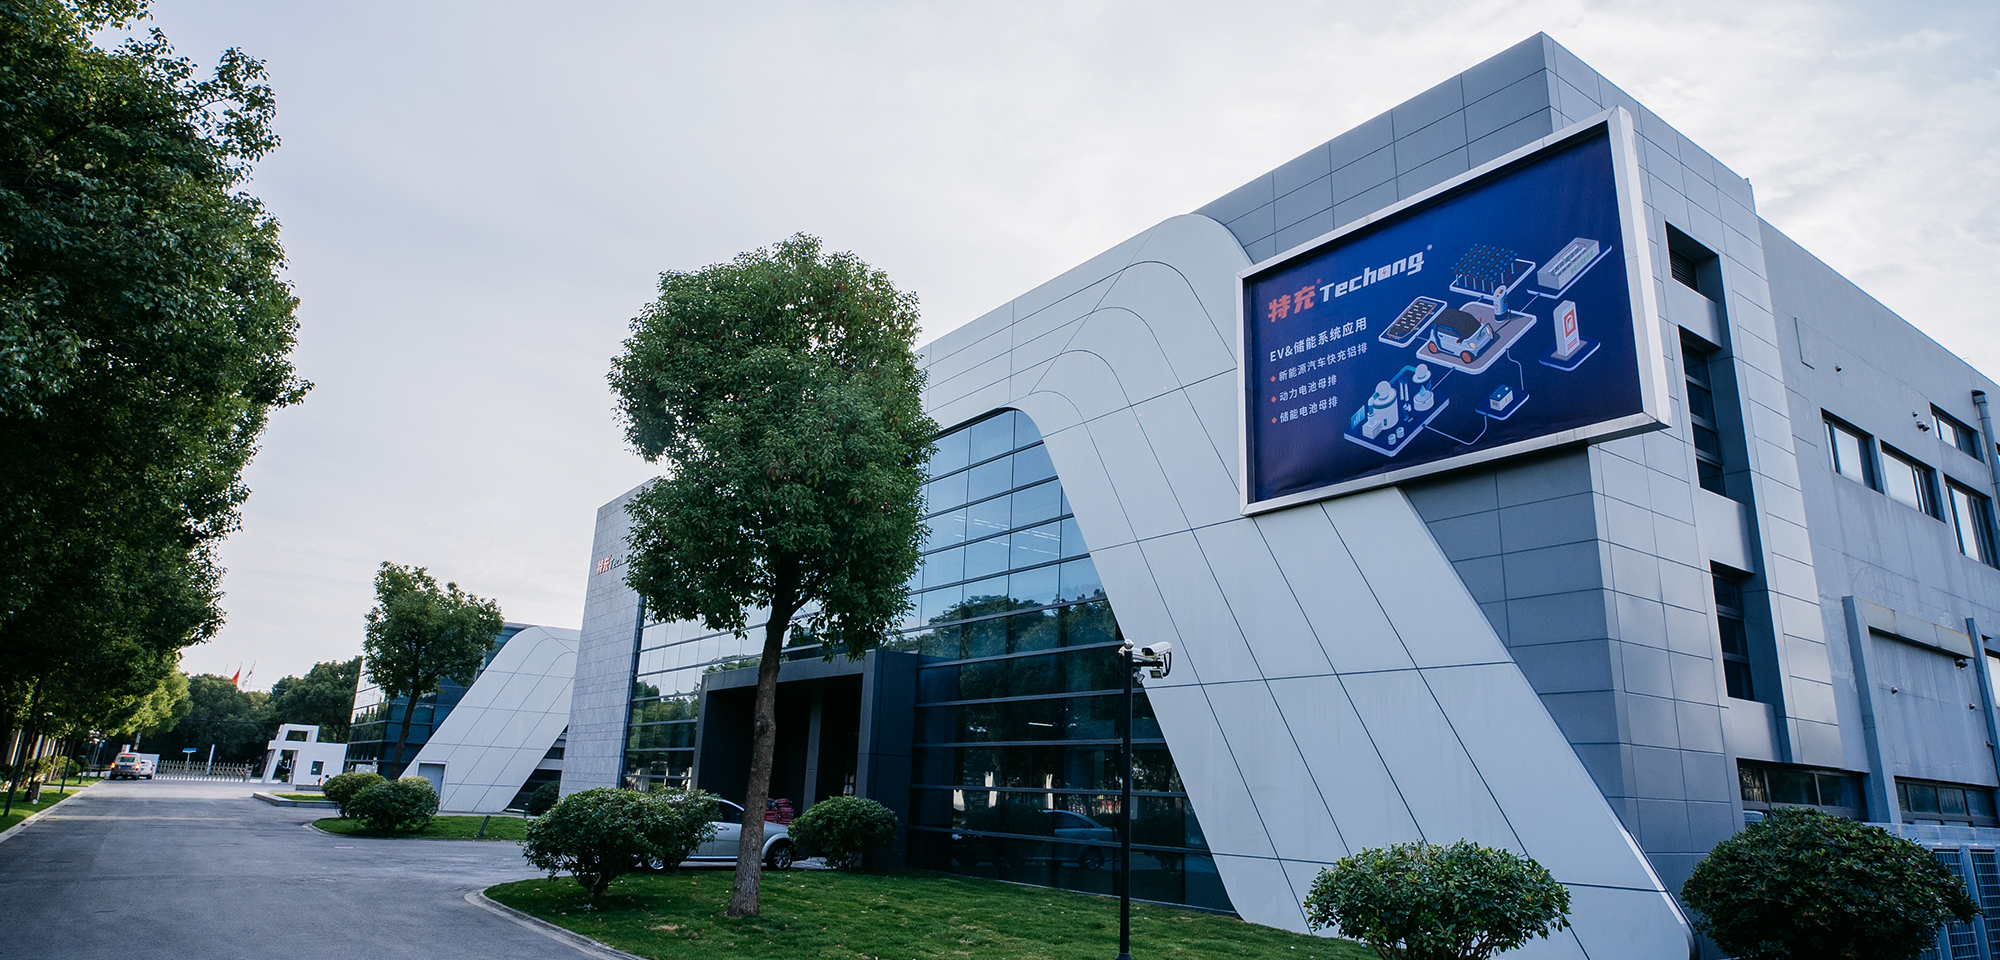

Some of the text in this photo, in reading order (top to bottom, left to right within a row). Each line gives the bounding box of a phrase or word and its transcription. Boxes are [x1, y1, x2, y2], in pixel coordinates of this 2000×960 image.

[1267, 251, 1425, 323] 特充 Techong
[1270, 317, 1367, 362] EV&储能系统应用
[1278, 342, 1368, 381] 新能源汽车快充铝排
[1279, 374, 1337, 402] 动力电池母排
[1280, 396, 1338, 423] 储能电池母排
